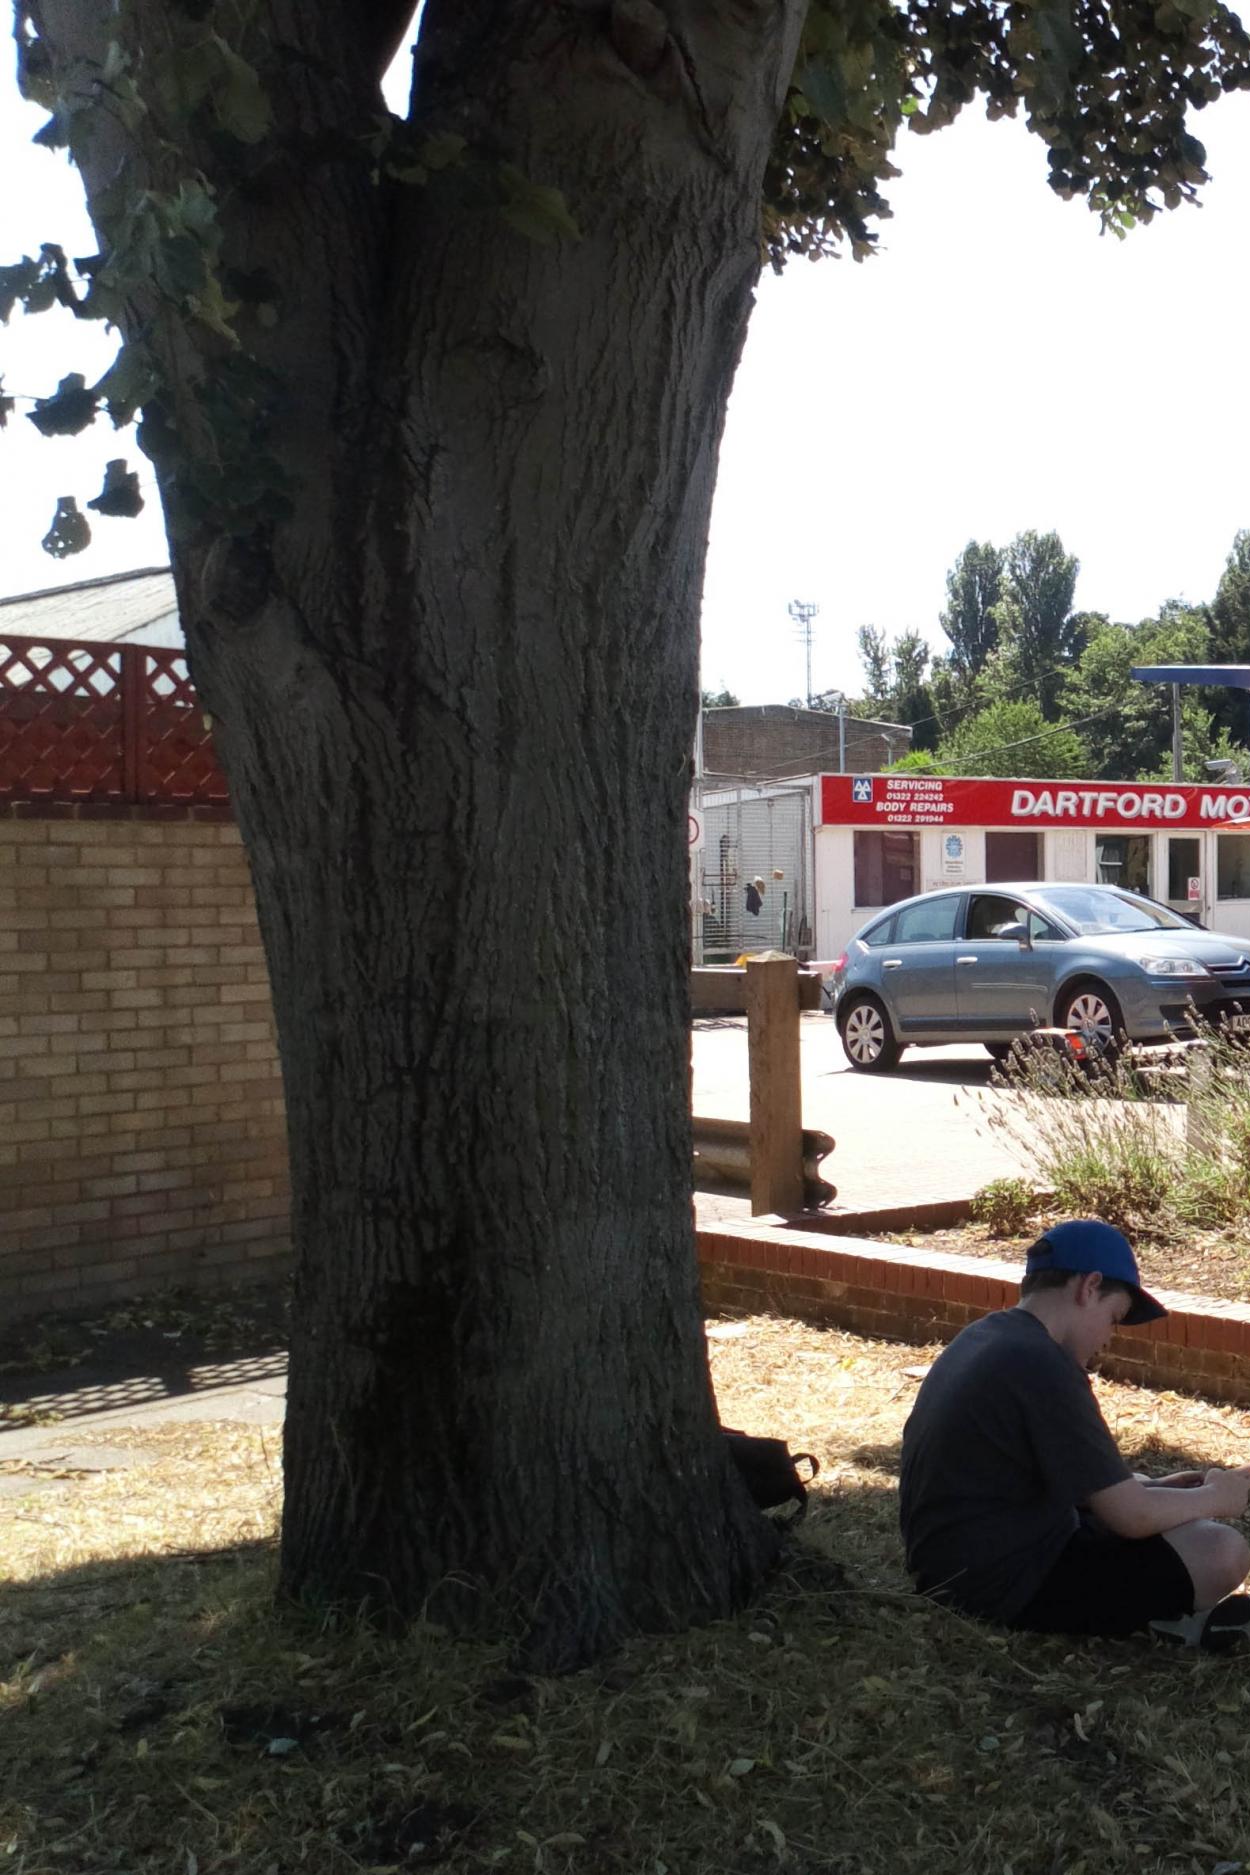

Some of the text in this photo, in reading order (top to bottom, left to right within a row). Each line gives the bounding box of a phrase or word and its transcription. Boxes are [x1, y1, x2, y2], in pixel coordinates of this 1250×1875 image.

[887, 780, 942, 790] SERVICING
[876, 802, 953, 813] BODY REPAIRS
[1010, 790, 1187, 818] DARTFORD
[887, 814, 912, 822] 01322
